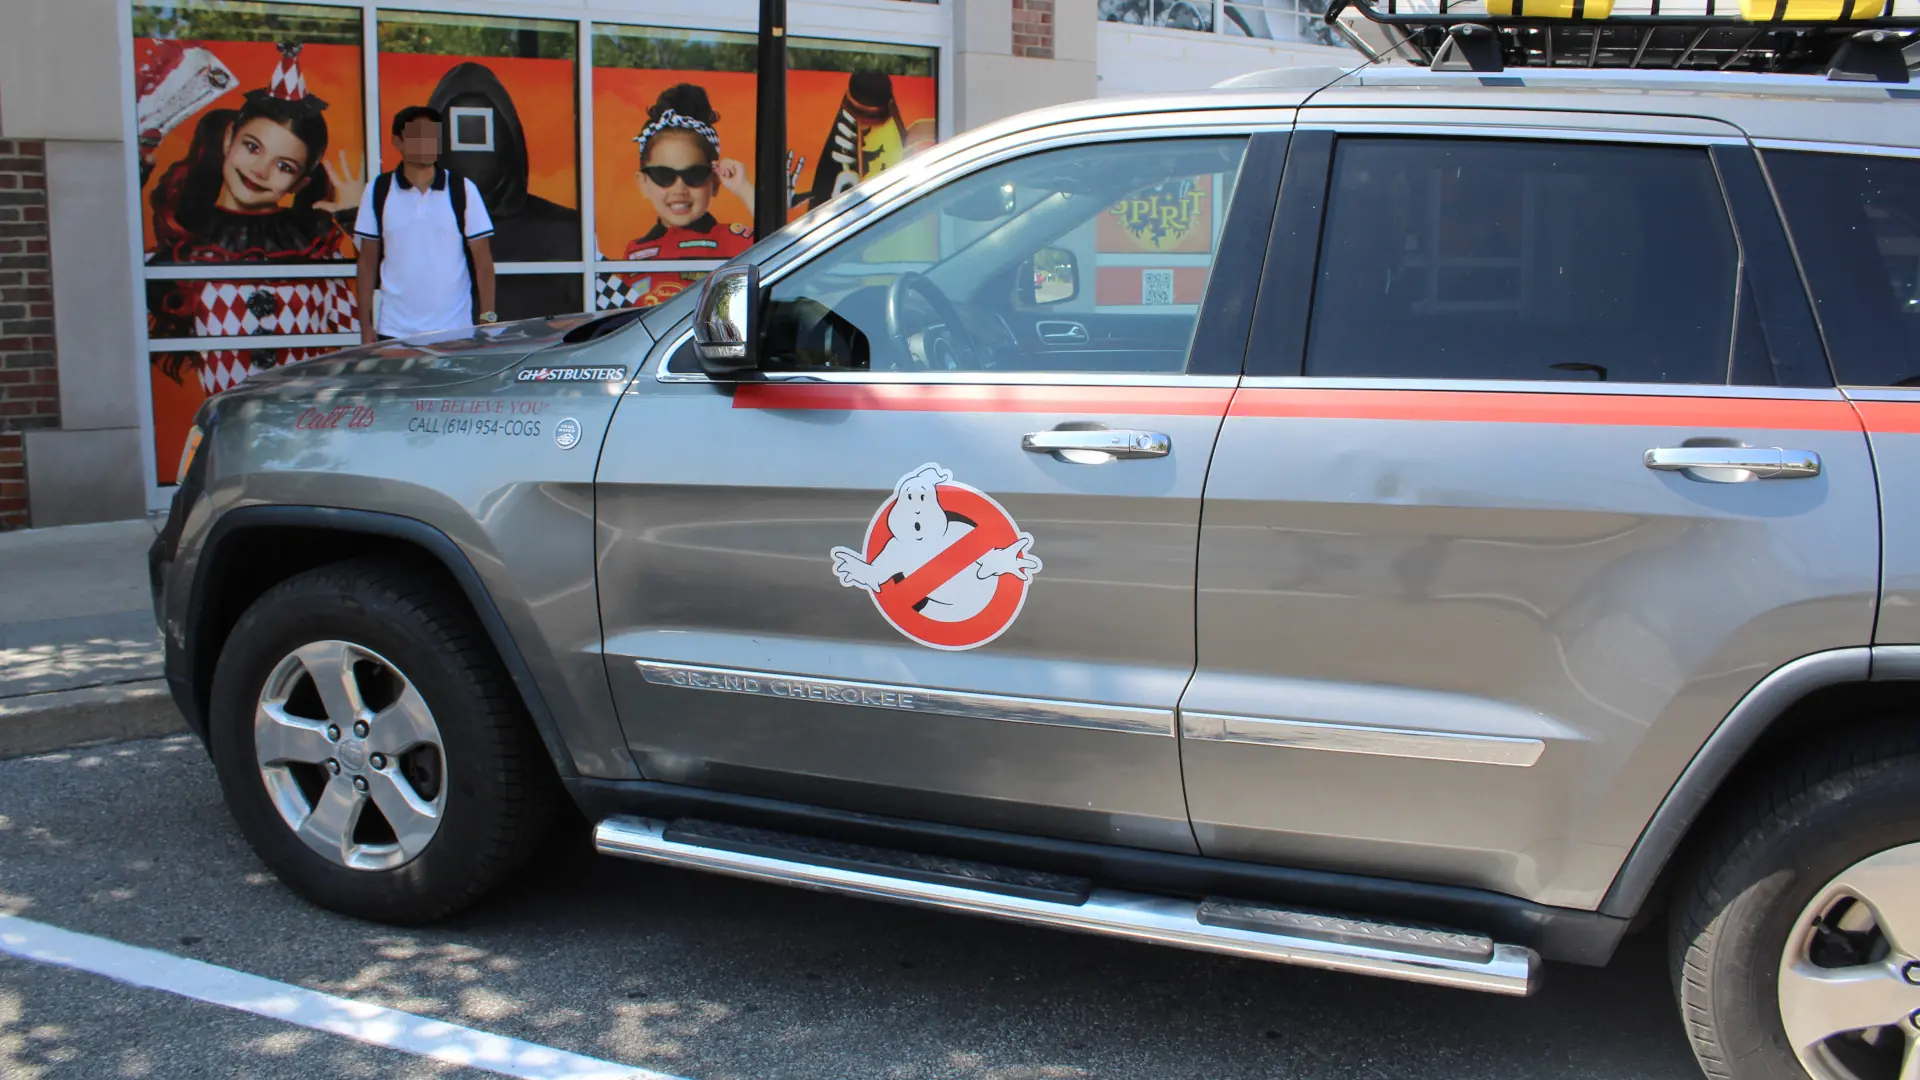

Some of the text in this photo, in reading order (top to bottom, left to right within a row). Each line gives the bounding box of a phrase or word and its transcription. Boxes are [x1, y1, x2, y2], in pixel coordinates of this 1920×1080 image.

[296, 405, 375, 430] Call Us
[440, 399, 505, 414] BELIEVE
[408, 417, 439, 433] CALL
[442, 418, 473, 436] (614)
[475, 419, 541, 437] 954-COGS
[670, 671, 915, 709] GRAND CHEROKEE
